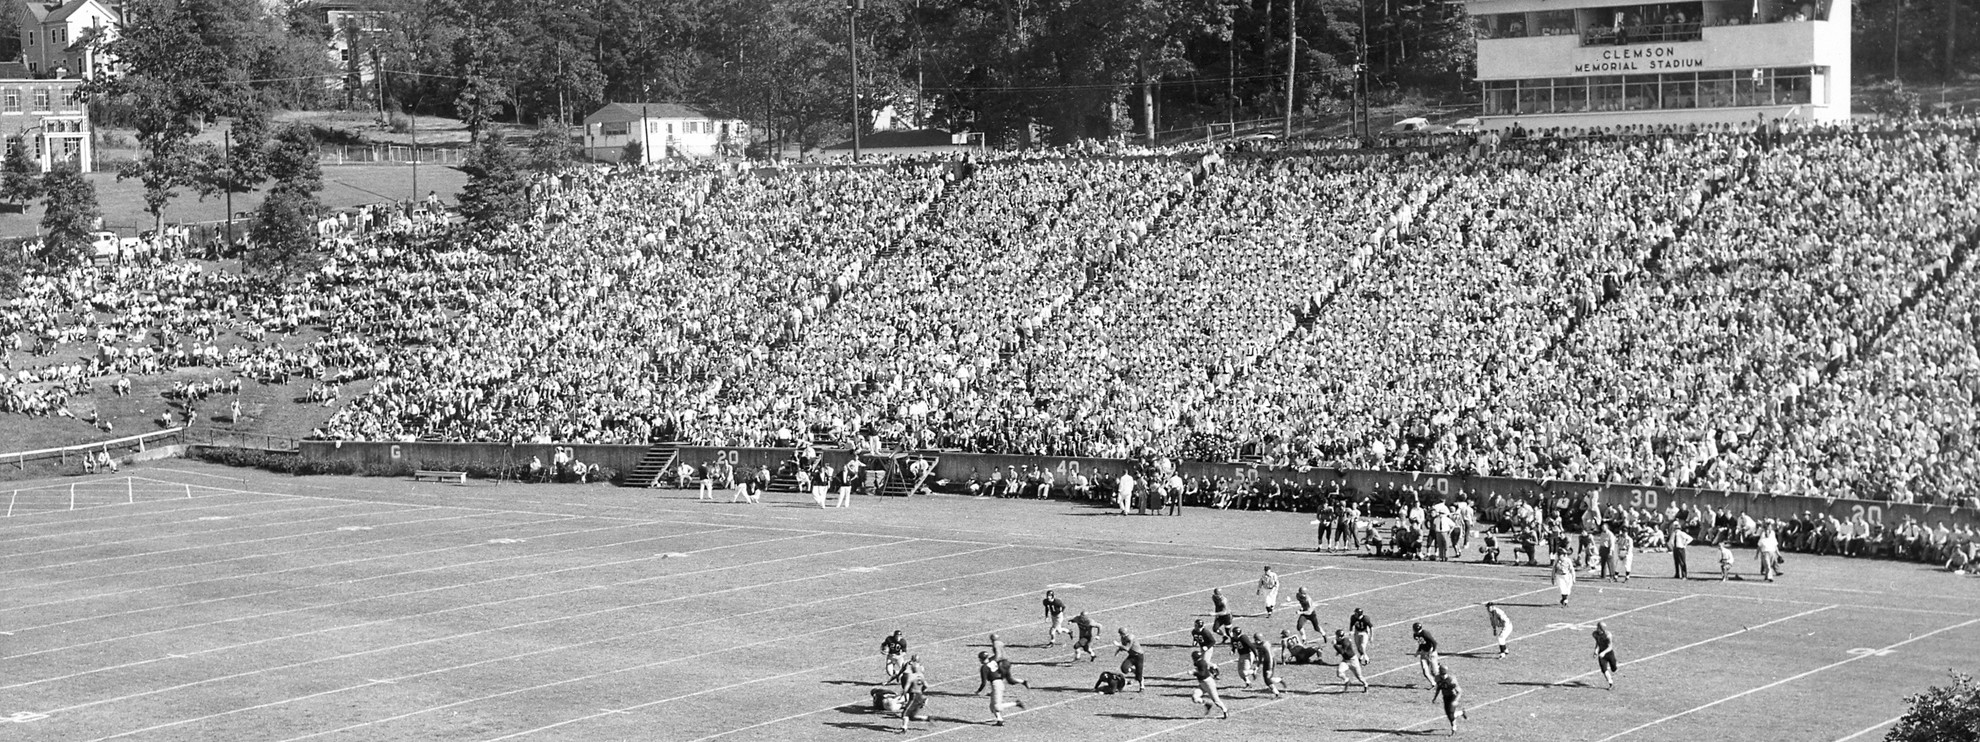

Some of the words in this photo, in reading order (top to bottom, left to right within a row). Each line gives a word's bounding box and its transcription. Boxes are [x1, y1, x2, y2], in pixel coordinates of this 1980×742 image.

[1603, 47, 1674, 59] CLEMSON
[1575, 62, 1637, 72] MEMORIAL
[1650, 59, 1703, 69] STADIUM
[391, 445, 401, 458] G
[717, 450, 738, 464] 20
[1057, 460, 1079, 476] 40
[1235, 467, 1258, 482] 50
[1424, 477, 1448, 495] 40
[1631, 489, 1657, 508] 30
[1852, 504, 1881, 525] 20
